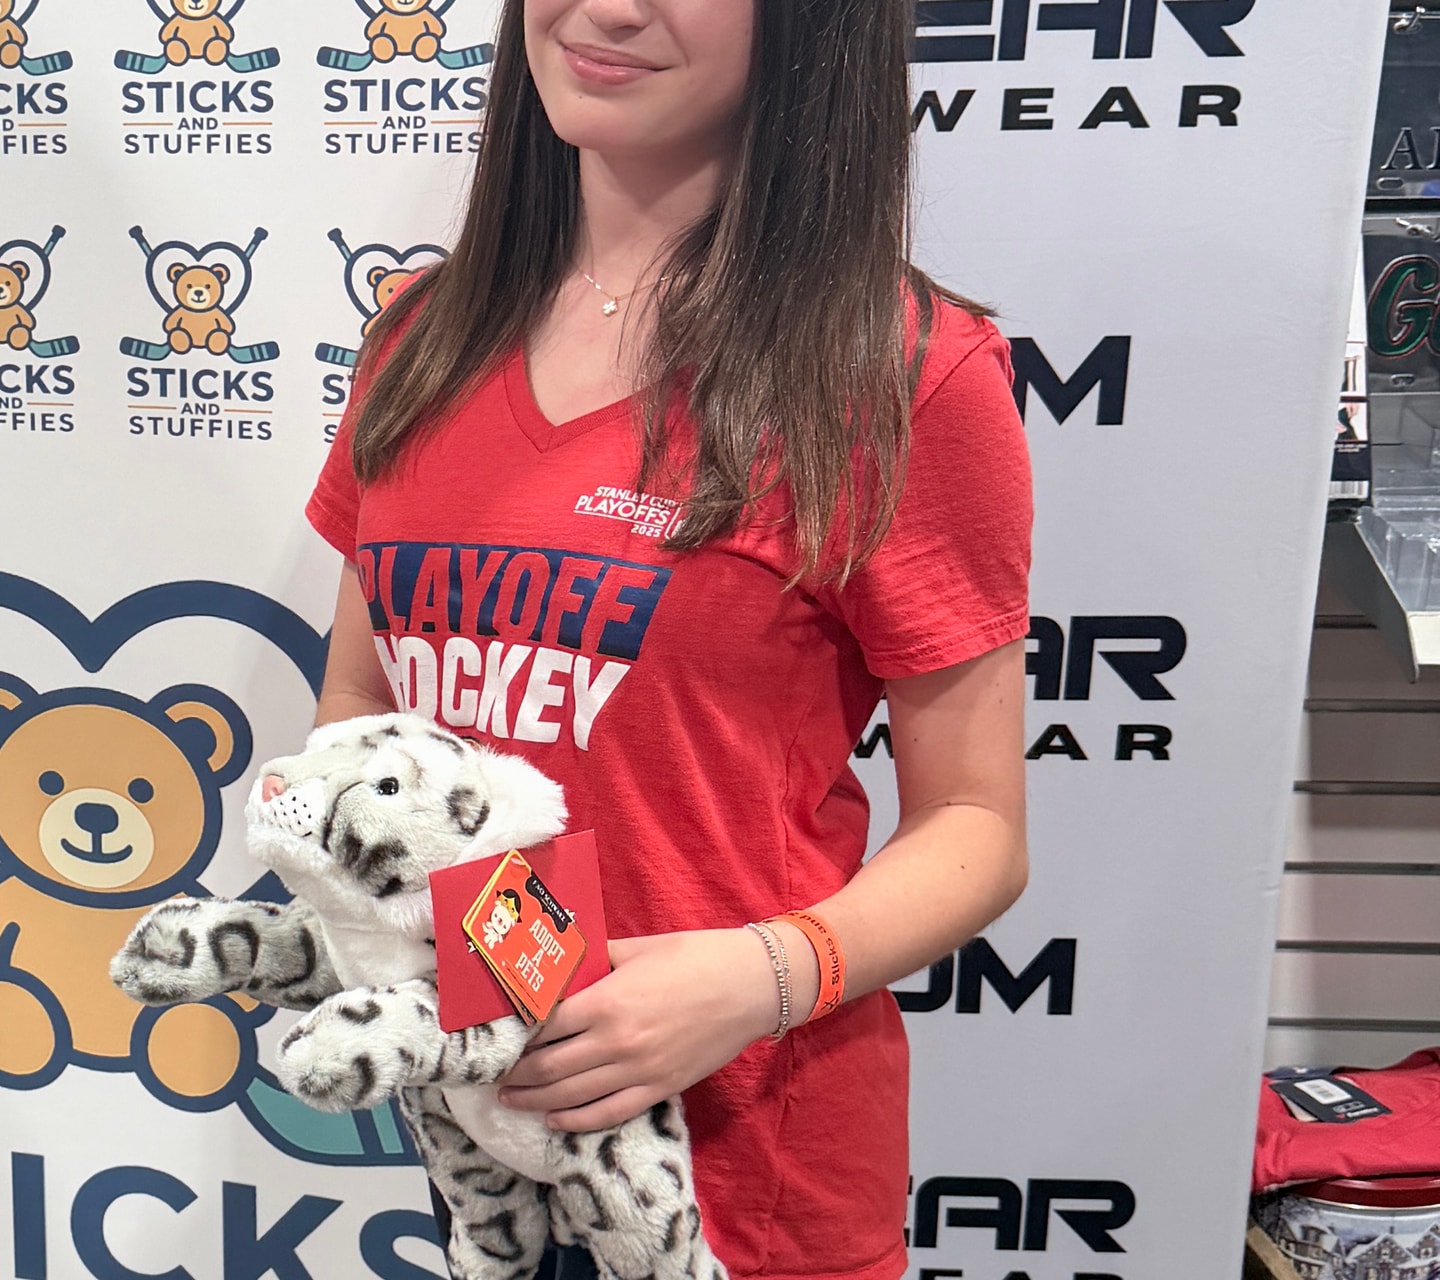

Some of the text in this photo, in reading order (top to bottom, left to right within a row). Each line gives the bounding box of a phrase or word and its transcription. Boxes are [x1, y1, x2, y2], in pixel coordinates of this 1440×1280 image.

[121, 79, 274, 114] STICKS
[323, 77, 488, 112] STICKS
[177, 116, 219, 131] AND
[382, 116, 427, 131] AND
[123, 132, 272, 156] STUFFIES
[324, 131, 483, 155] STUFFIES
[126, 367, 275, 403] STICKS
[180, 402, 221, 418] AND
[129, 416, 273, 442] STUFFIES
[594, 486, 650, 505] STANLEY
[574, 494, 671, 526] PLAYOFFS
[630, 524, 664, 538] 2025
[373, 634, 631, 751] HOCKEY
[528, 918, 566, 966] ADOPT
[530, 948, 545, 969] A
[514, 951, 545, 993] PETS
